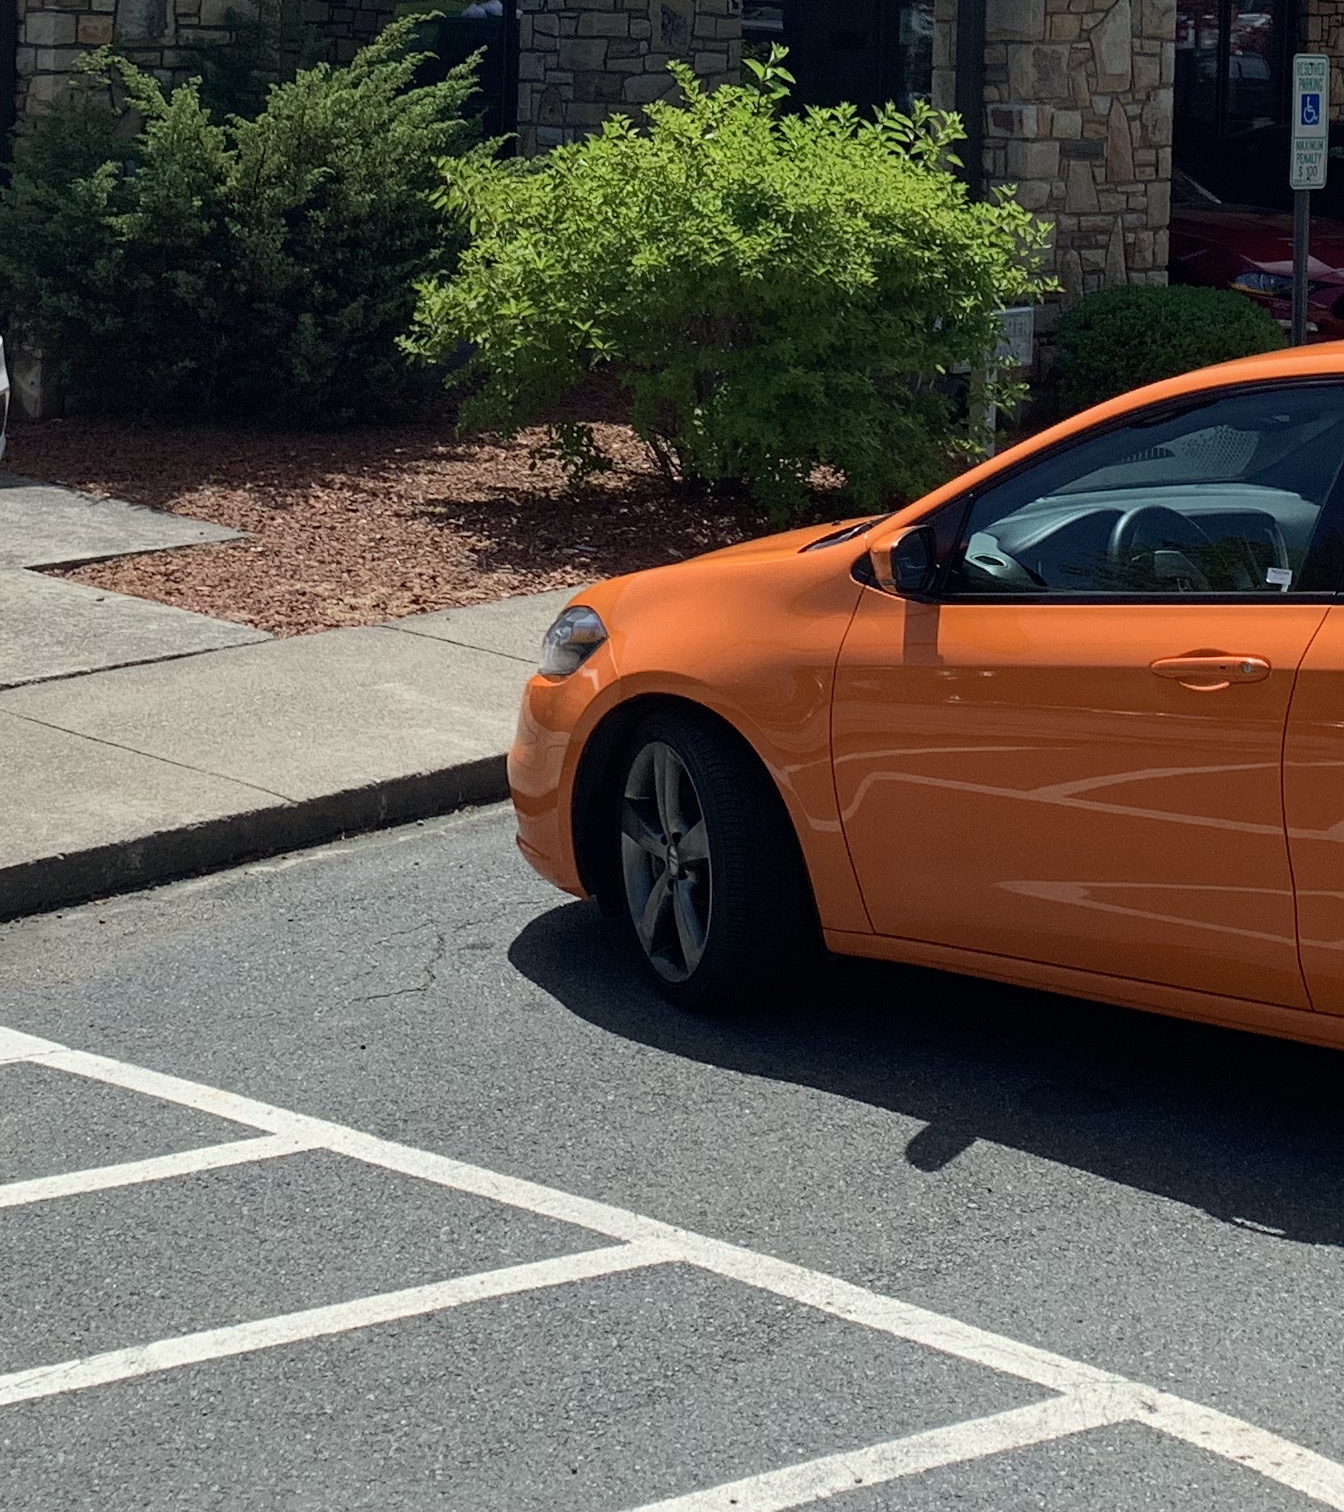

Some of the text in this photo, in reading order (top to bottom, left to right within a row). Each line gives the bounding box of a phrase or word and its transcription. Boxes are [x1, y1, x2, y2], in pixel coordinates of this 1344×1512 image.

[1296, 61, 1325, 76] RESERVED
[1298, 77, 1323, 91] PARKING
[1295, 140, 1324, 150] MAXIMUM
[1296, 152, 1322, 164] PENALTY
